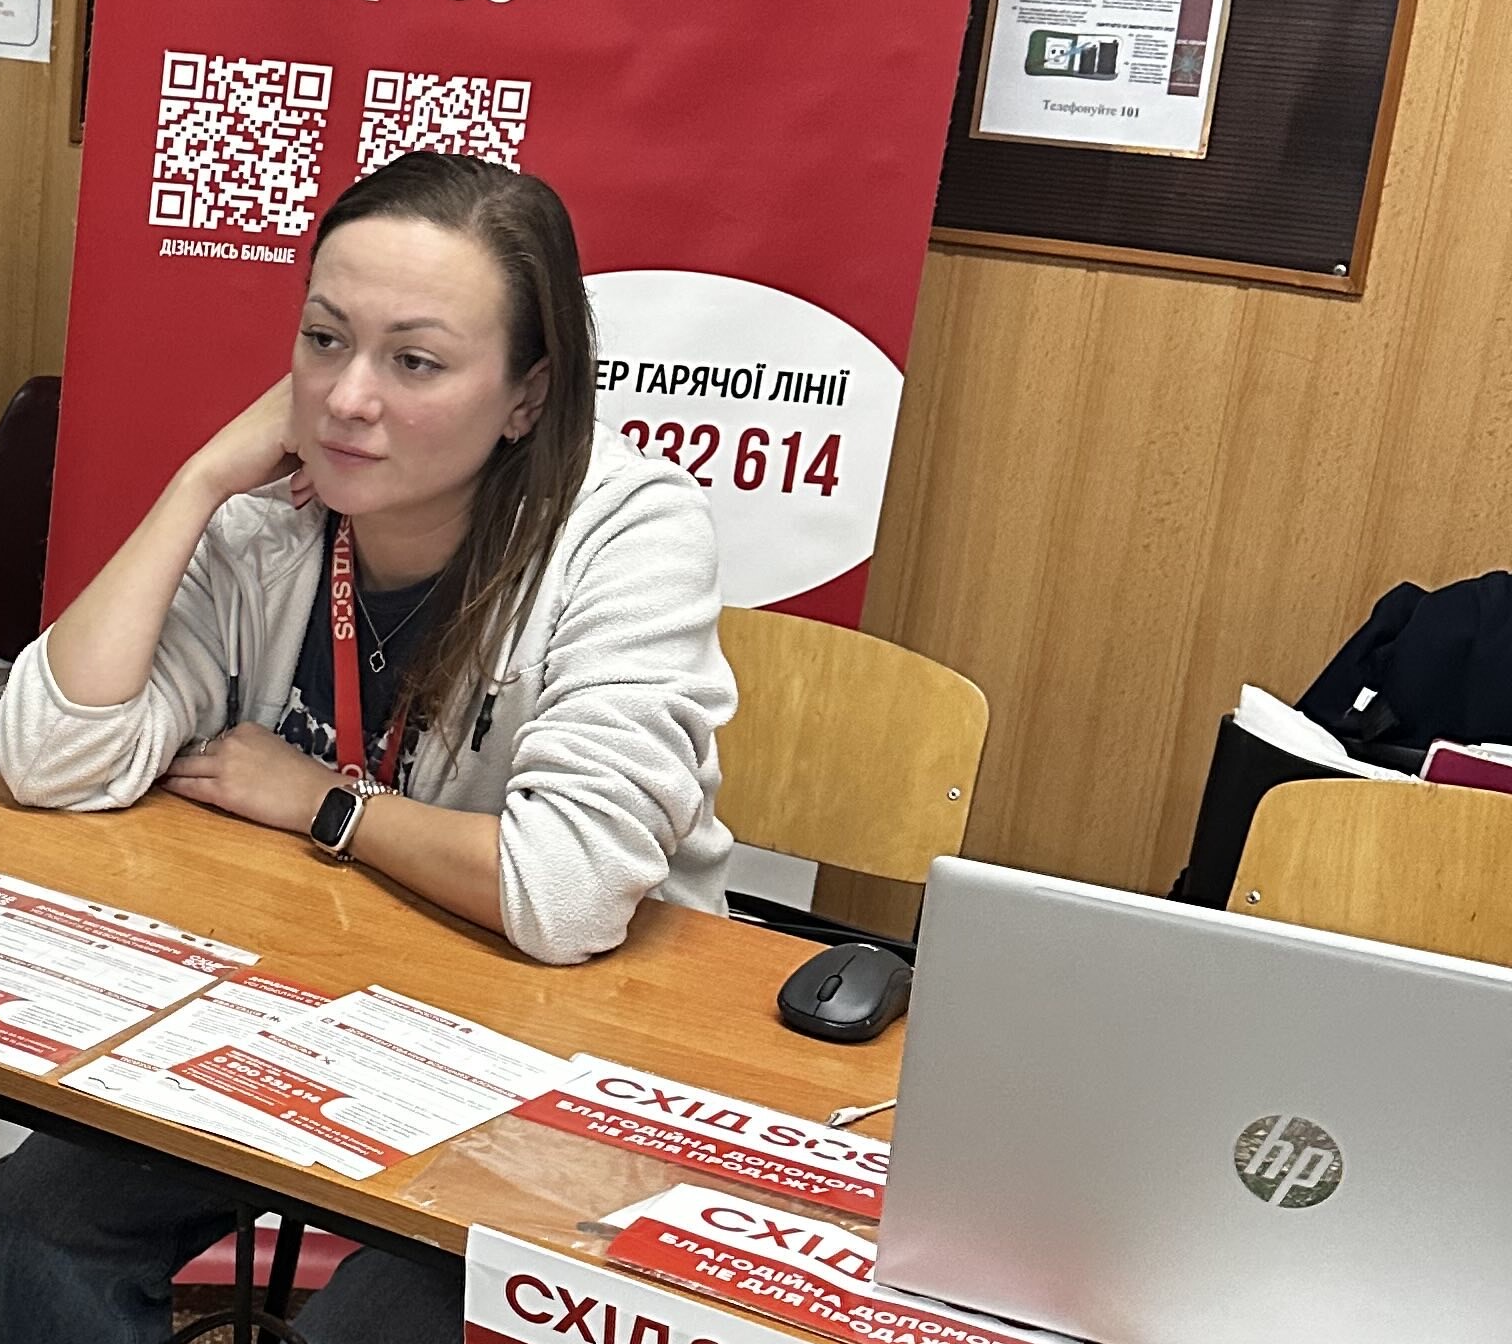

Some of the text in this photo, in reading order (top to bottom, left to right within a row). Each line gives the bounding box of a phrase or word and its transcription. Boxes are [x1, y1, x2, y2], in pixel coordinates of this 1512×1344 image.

[1042, 99, 1140, 119] Телефонуйте 101
[159, 238, 296, 264] ДІЗНАТИСЬ БІЛЬШЕ
[635, 362, 767, 400] ГАРЯЧОЇ
[769, 369, 850, 406] ЛІНІЇ
[733, 427, 841, 497] 614
[333, 580, 356, 641] SOS
[556, 1099, 877, 1200] БЛАГОДІЙНА ДОПОМОГА
[587, 1120, 831, 1196] НЕ ДЛЯ ПРОДАЖУ
[596, 1076, 891, 1173] СХІД SOS
[1245, 1115, 1336, 1208] hp
[657, 1232, 844, 1309] БЛАГОДІЙНА
[694, 1259, 736, 1283] НЕ
[737, 1276, 803, 1308] ДЛЯ
